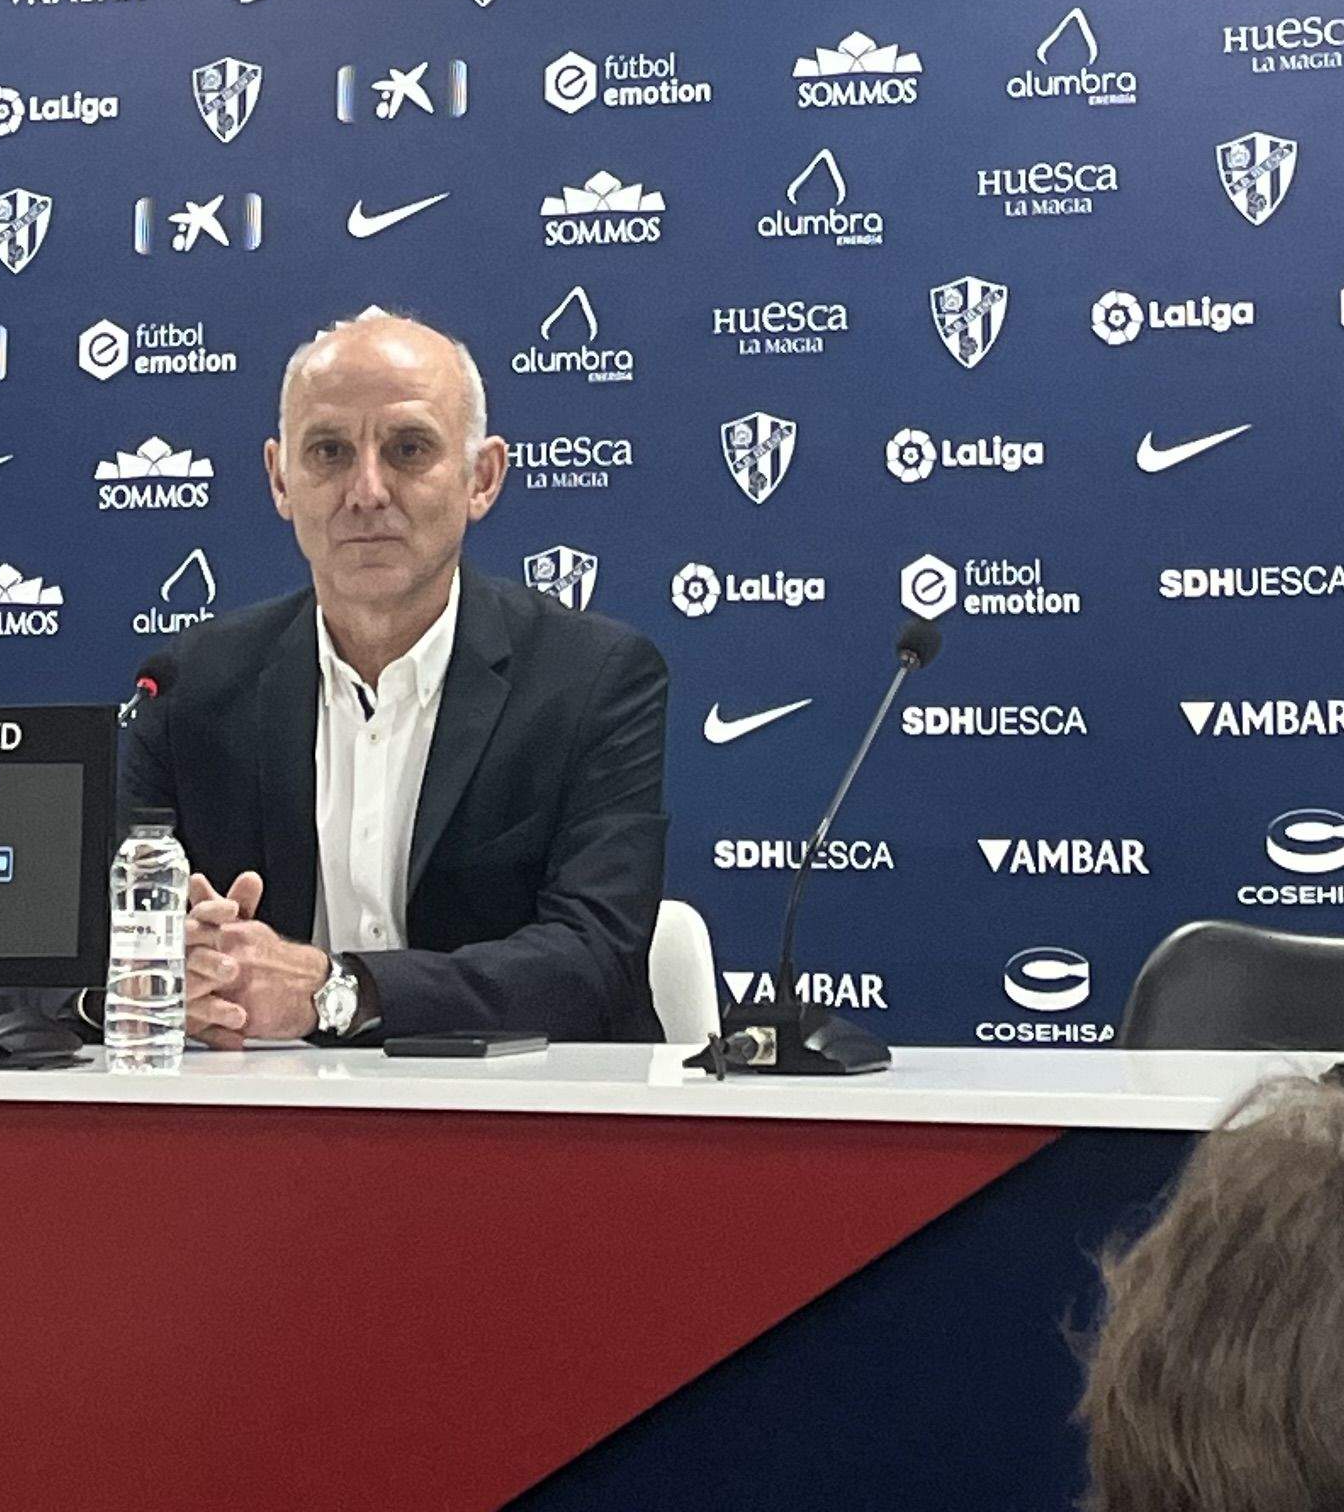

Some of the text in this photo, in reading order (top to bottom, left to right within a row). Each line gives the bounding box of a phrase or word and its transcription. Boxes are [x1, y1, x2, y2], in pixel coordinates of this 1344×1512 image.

[605, 52, 674, 79] fútbol
[604, 78, 711, 106] emotion
[798, 78, 917, 107] SOMMOS
[1007, 68, 1136, 97] alumbra
[30, 91, 118, 124] LaLiga
[546, 217, 660, 246] SOMMOS
[758, 208, 883, 236] alumbra
[1149, 296, 1253, 332] LaLiga
[136, 322, 203, 348] fútbol
[135, 348, 236, 373] emotion
[512, 345, 633, 373] alumbra
[942, 435, 1043, 471] LaLiga
[99, 483, 208, 509] SOMMOS
[964, 558, 1040, 586] fútbol
[726, 571, 825, 606] LaLiga
[964, 586, 1080, 614] emotion
[1010, 839, 1149, 874] AMBAR
[976, 1023, 1114, 1039] COSEHISA
